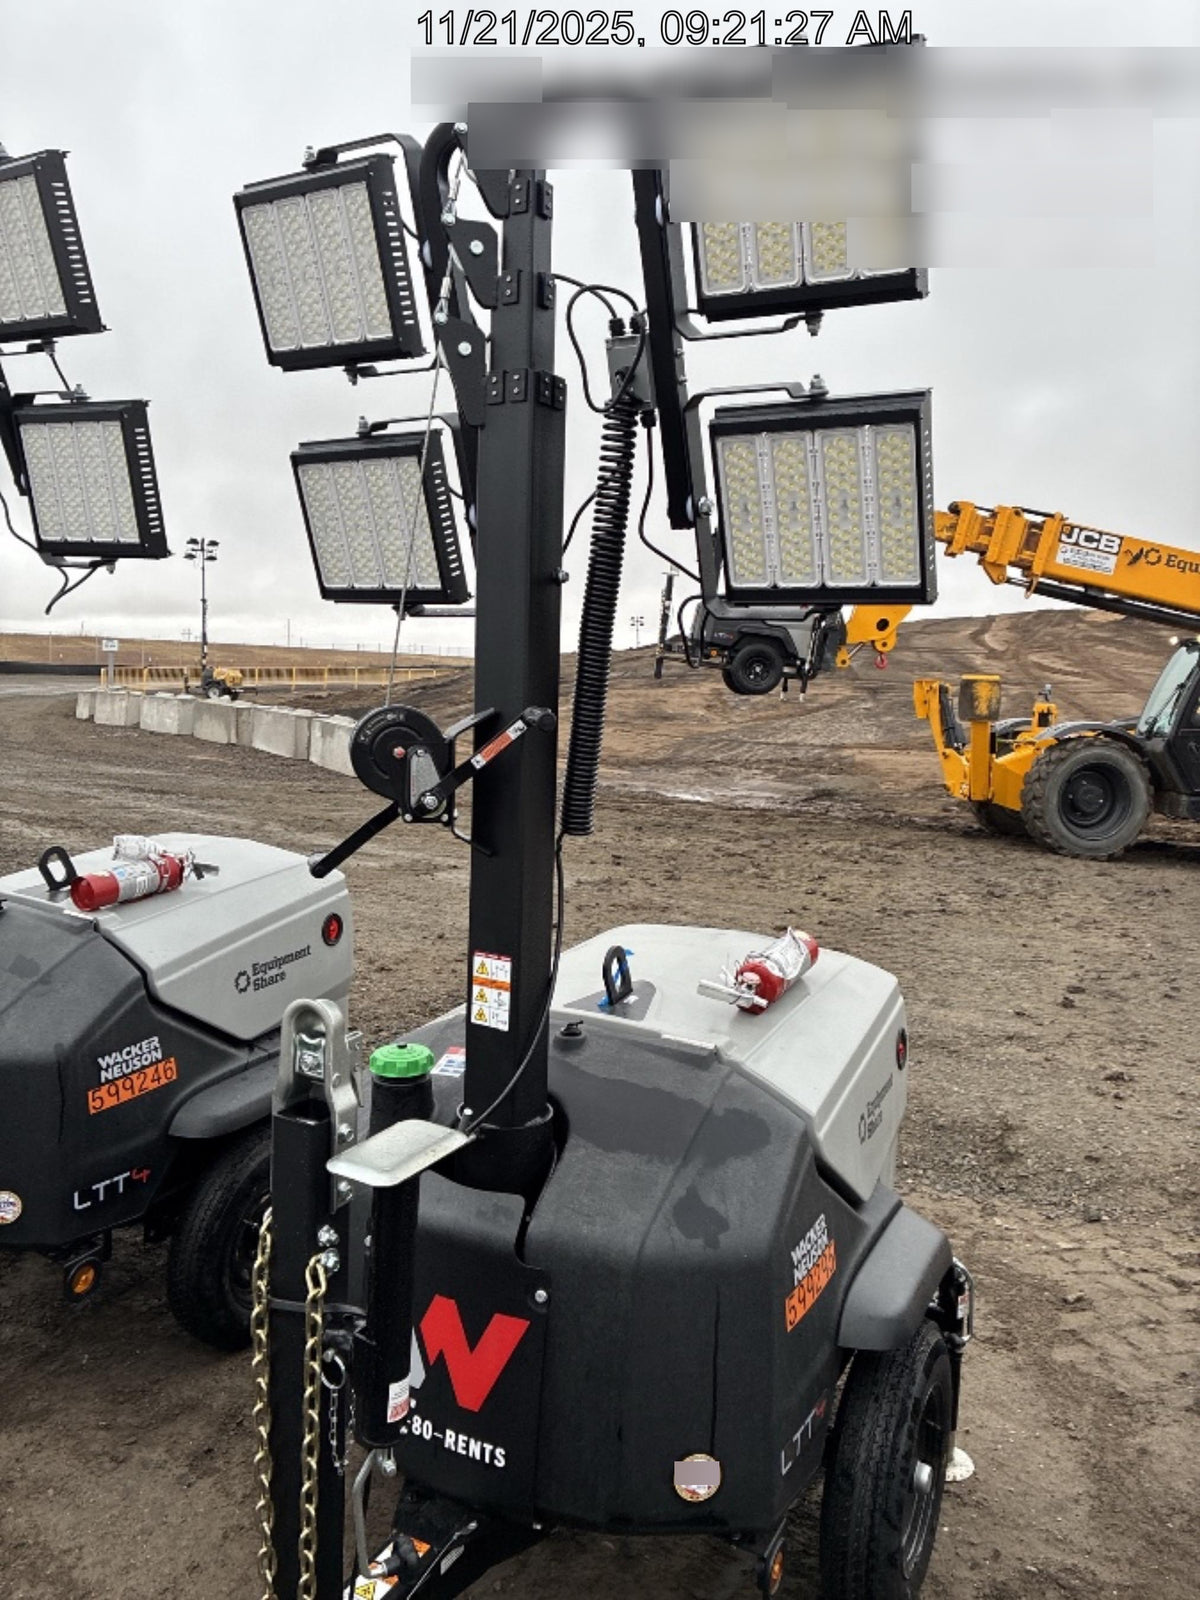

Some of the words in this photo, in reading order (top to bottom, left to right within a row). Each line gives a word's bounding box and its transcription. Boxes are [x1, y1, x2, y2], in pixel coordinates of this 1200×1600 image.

[1061, 527, 1121, 554] JCB
[252, 944, 311, 977] Equipment
[97, 1036, 160, 1070] WACKER
[100, 1049, 162, 1084] NEUSON
[91, 1060, 175, 1111] 599246
